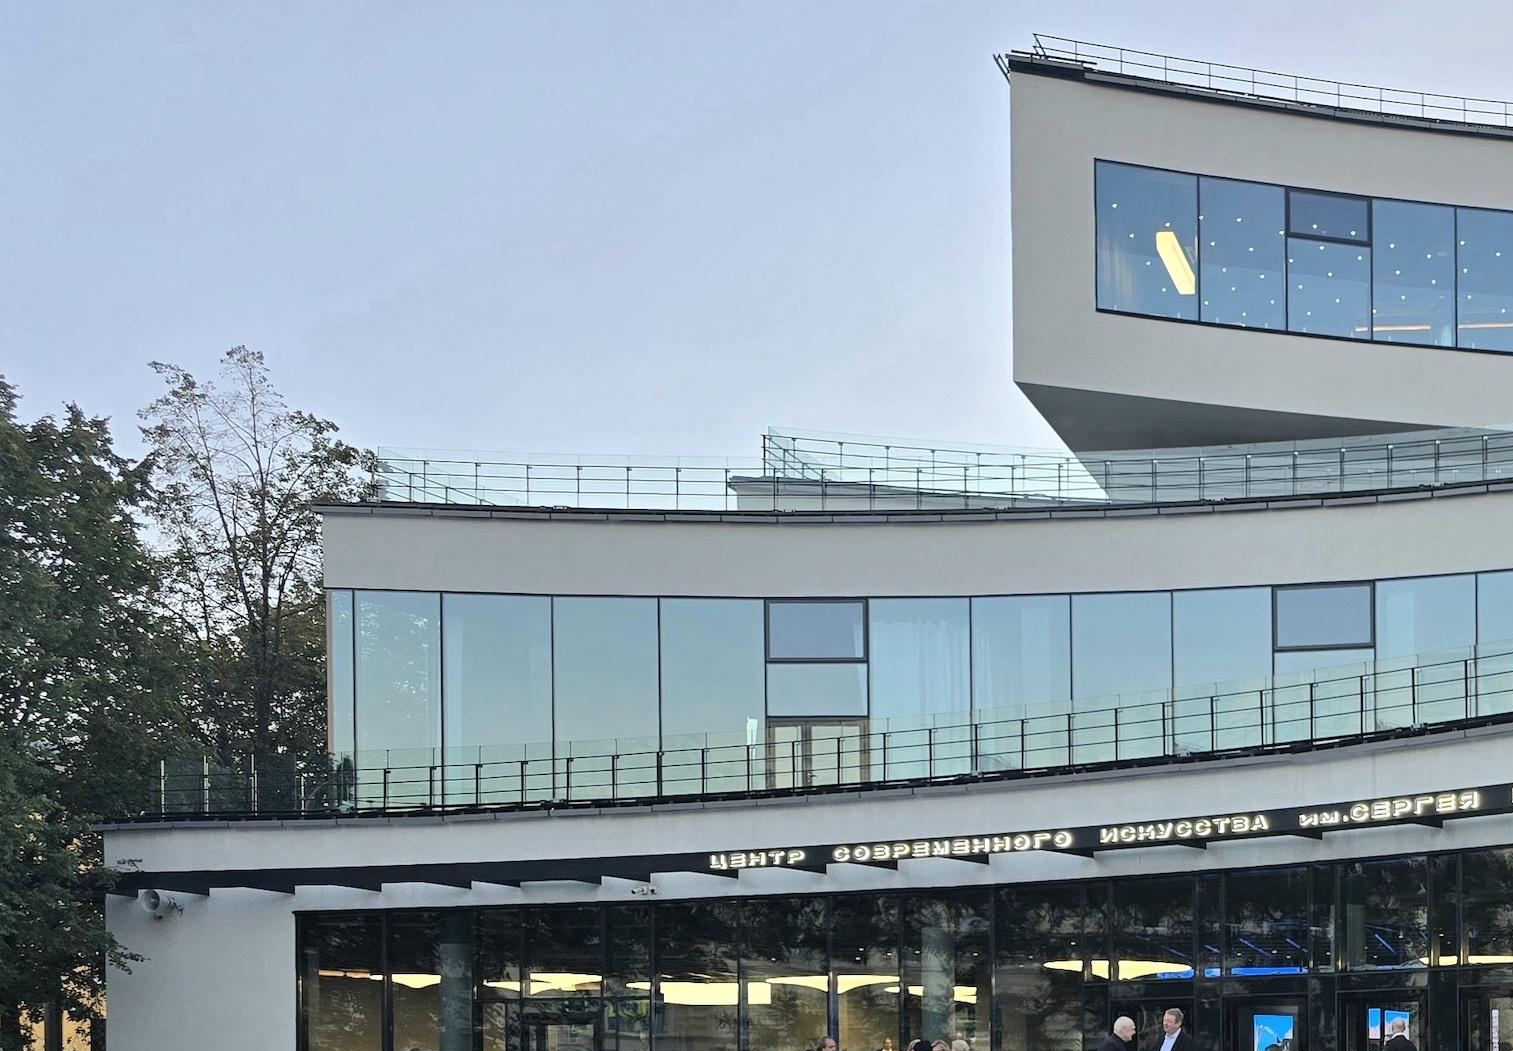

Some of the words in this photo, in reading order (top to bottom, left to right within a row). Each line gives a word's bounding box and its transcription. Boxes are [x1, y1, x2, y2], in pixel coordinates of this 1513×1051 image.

[709, 849, 806, 870] ЦЕНТР
[832, 831, 1073, 862] СОВРЕМЕННОГО
[1100, 814, 1270, 843] ИСКУССТВА
